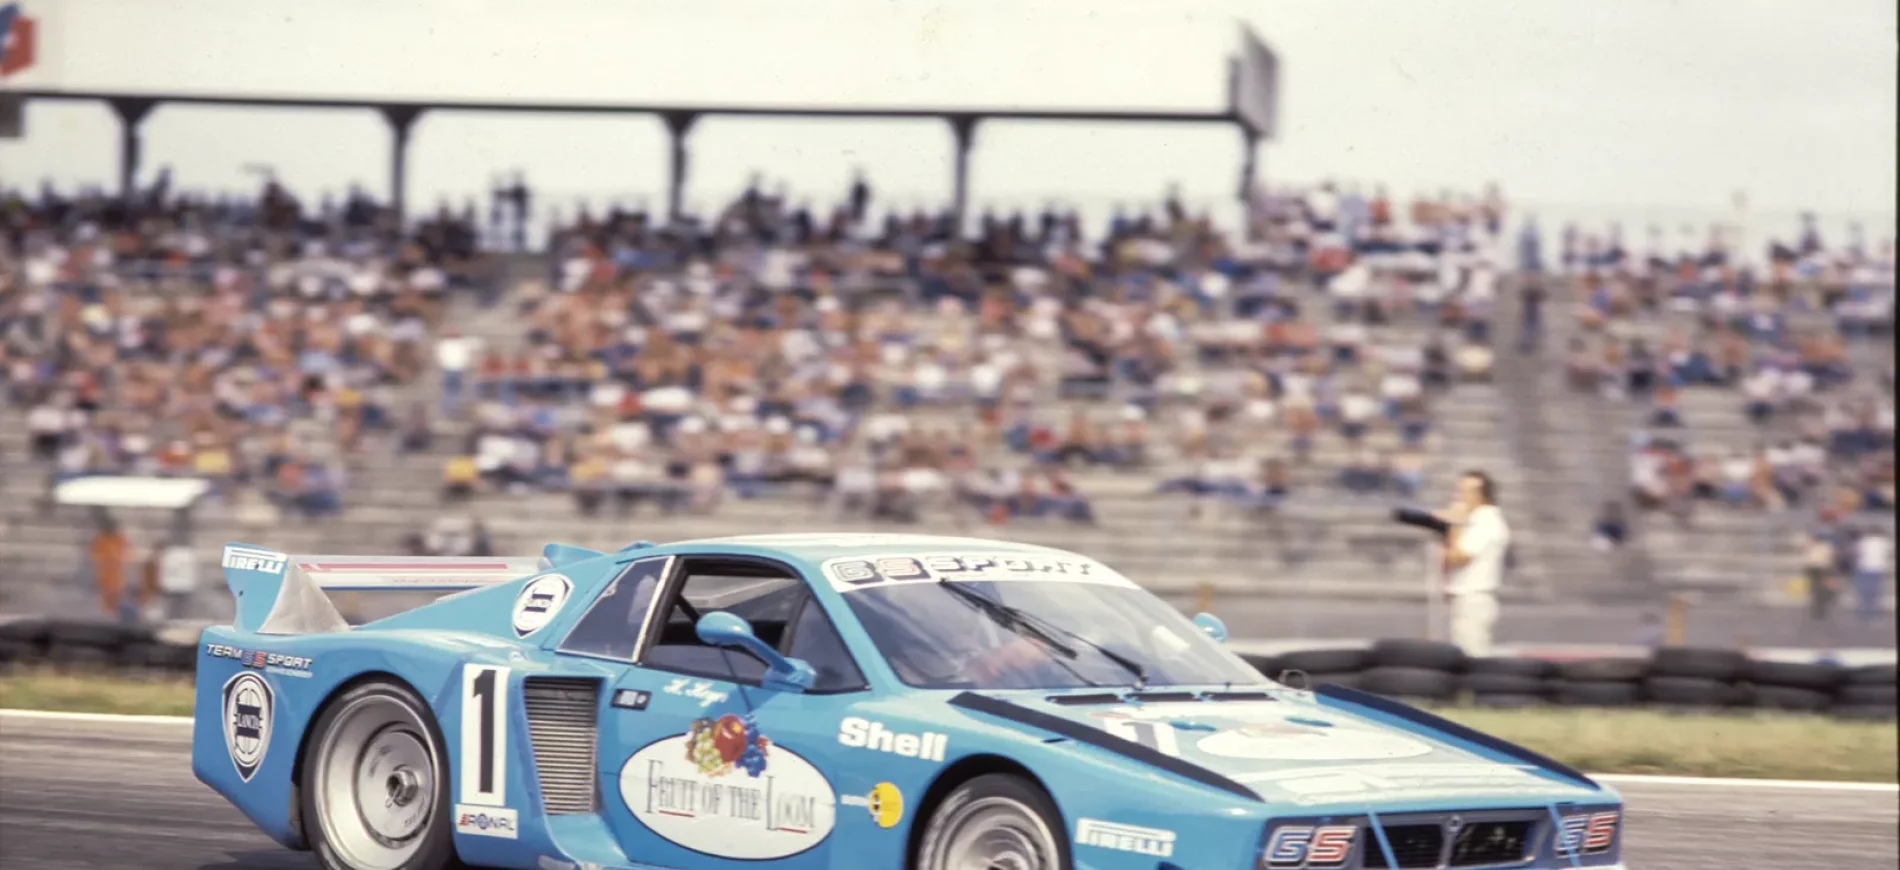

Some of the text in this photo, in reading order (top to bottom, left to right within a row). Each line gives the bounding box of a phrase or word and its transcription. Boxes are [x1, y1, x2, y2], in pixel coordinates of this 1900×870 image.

[222, 546, 287, 575] PIRELLI
[830, 557, 932, 585] GS
[206, 643, 243, 660] TEAM
[266, 653, 314, 669] SPORT
[473, 669, 496, 794] 1
[838, 716, 948, 762] Shell
[702, 783, 723, 815] OF
[727, 785, 761, 820] THE
[1075, 816, 1176, 858] PIRELLI
[1264, 825, 1357, 870] GS
[1554, 810, 1619, 860] GS
